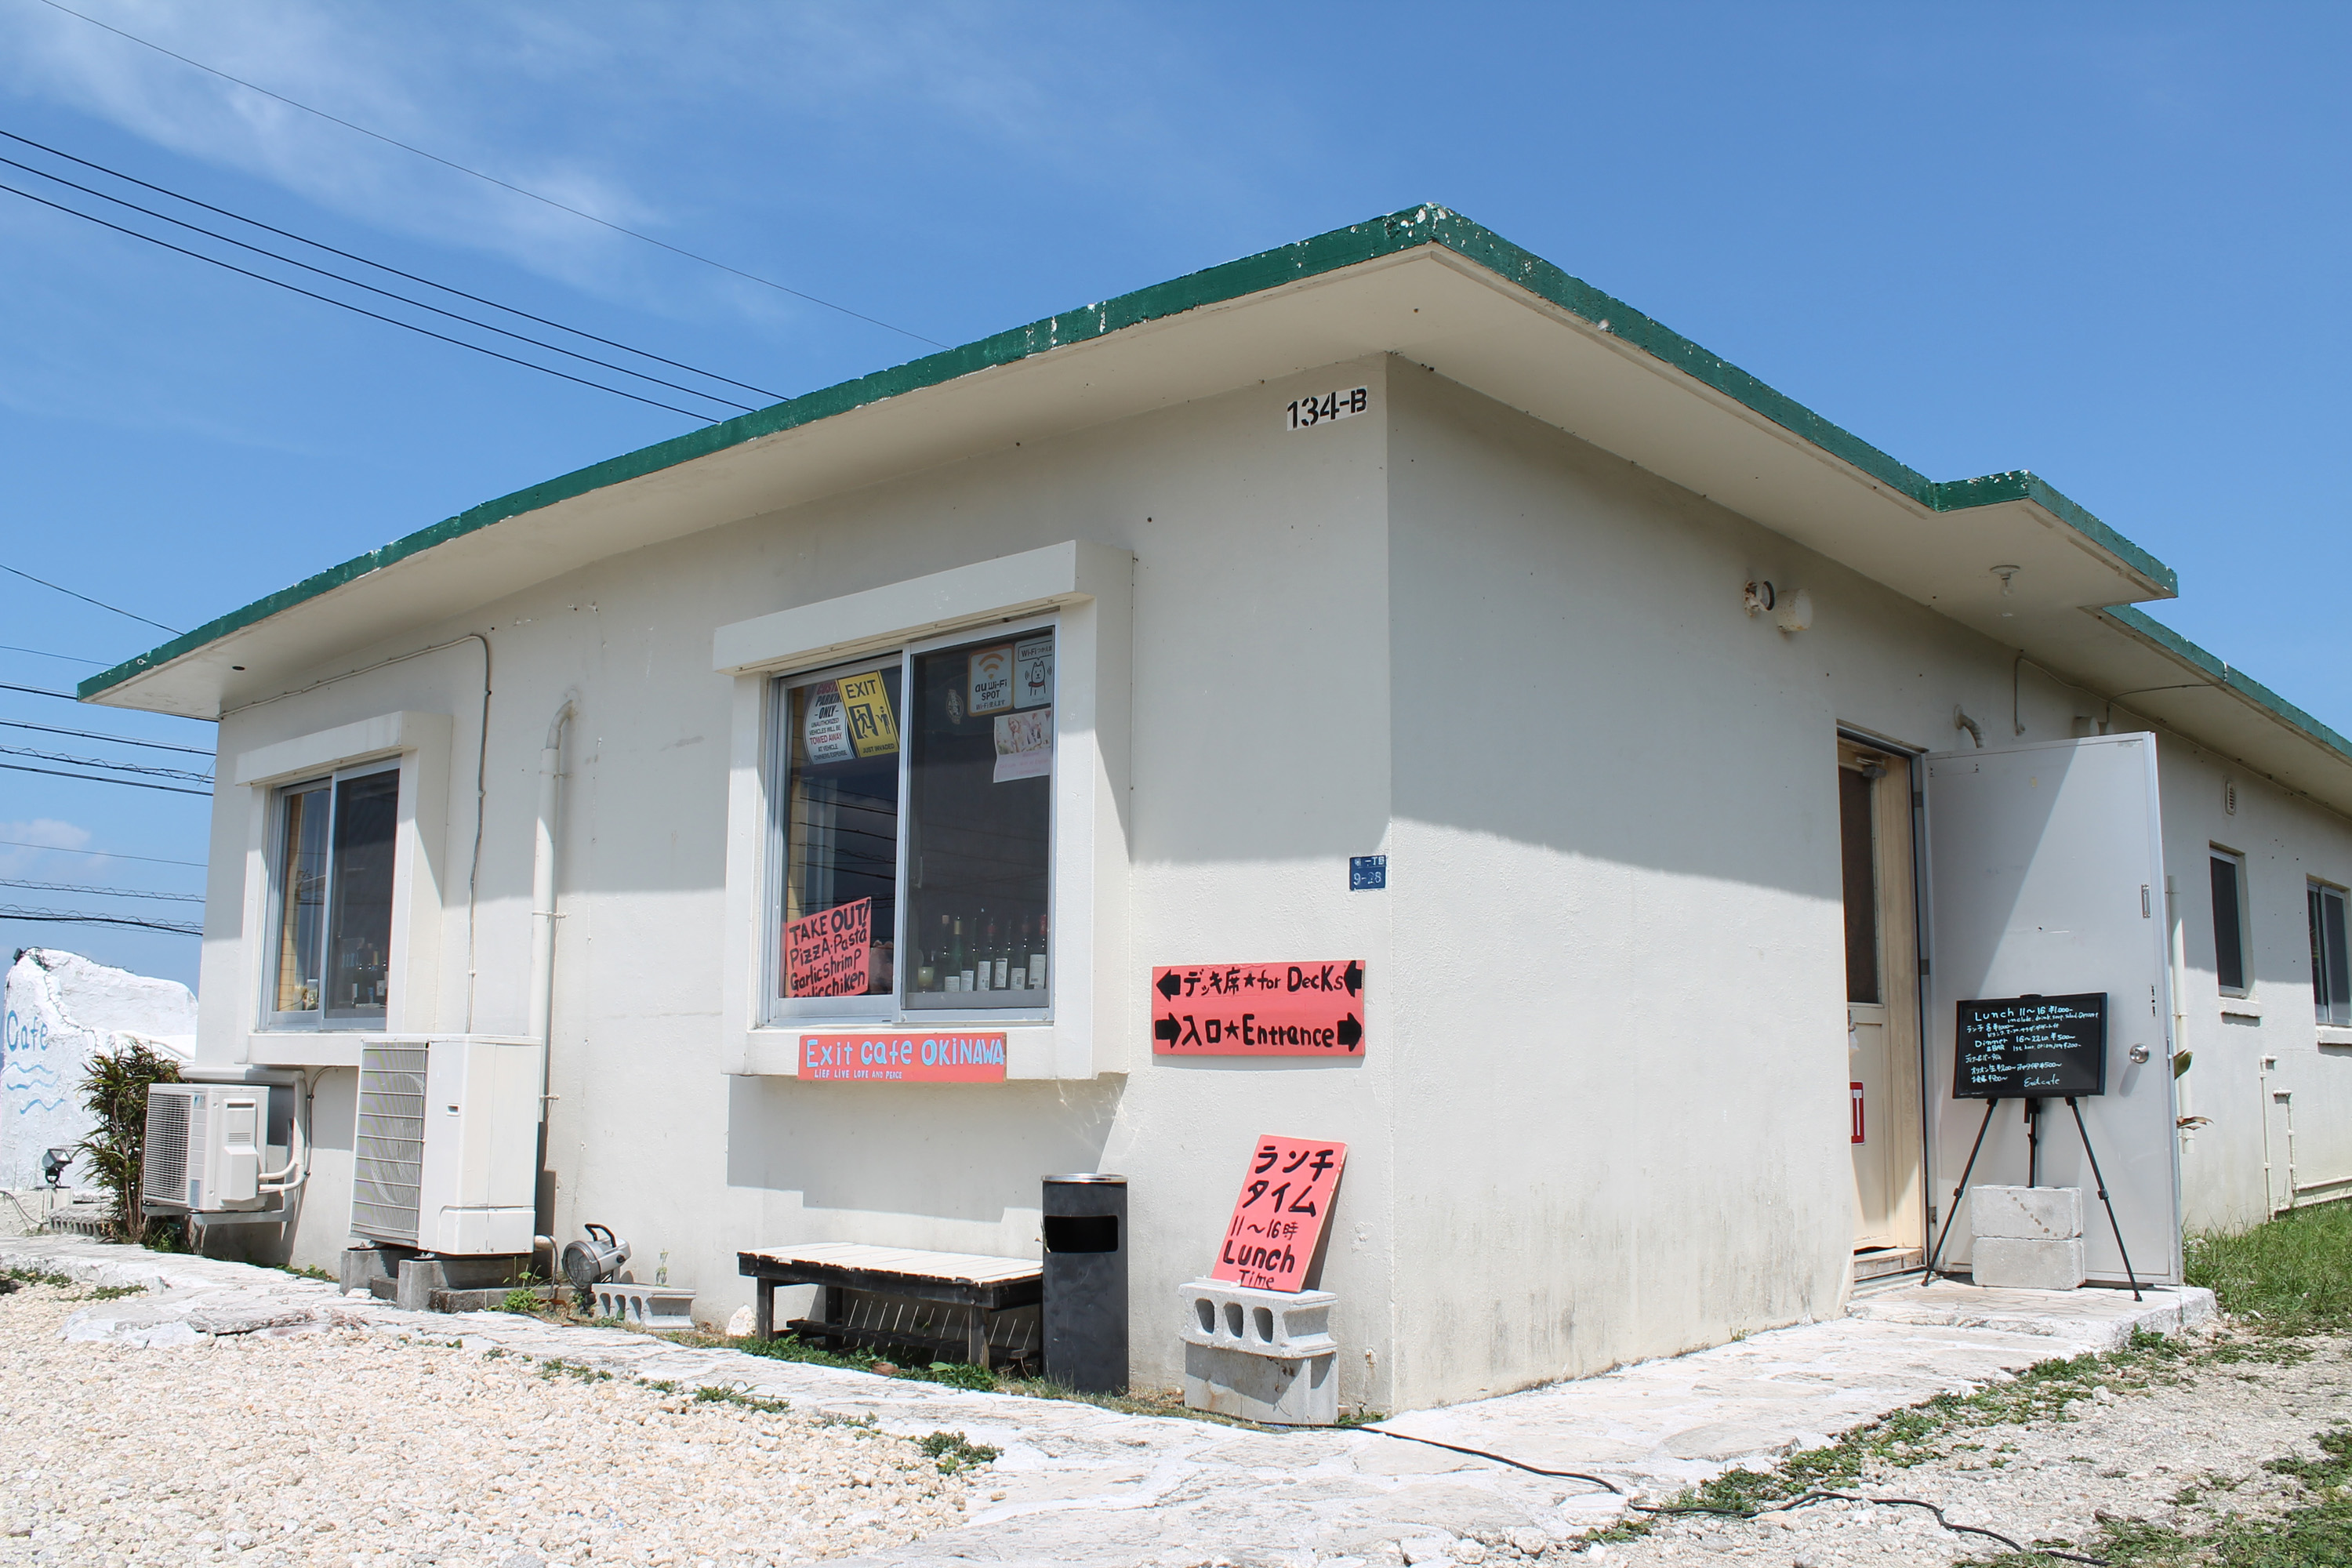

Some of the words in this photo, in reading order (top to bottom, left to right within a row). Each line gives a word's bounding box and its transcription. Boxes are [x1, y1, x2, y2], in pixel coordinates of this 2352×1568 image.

[1287, 388, 1367, 429] 134-B
[845, 679, 876, 699] EXIT
[975, 683, 987, 692] au
[988, 679, 1007, 690] Wi-Fi
[982, 690, 1000, 701] SPOT
[810, 735, 828, 745] TOWED
[829, 732, 842, 742] AWAY
[789, 915, 828, 946] TAKE
[831, 898, 870, 933] OUT!
[1184, 967, 1240, 996] デッキ席
[1257, 970, 1281, 991] for
[1975, 1007, 2014, 1022] Lunch
[6, 1010, 49, 1052] Cafe
[1181, 1014, 1221, 1047] 入口
[1243, 1014, 1334, 1047] Entrance
[1966, 1024, 1984, 1033] ランチ
[806, 1039, 853, 1068] Exit
[861, 1040, 913, 1065] cafe
[1975, 1038, 2008, 1047] Dinner
[854, 1069, 869, 1079] LOVE
[872, 1070, 884, 1079] AND
[885, 1070, 902, 1080] PEACE
[1255, 1145, 1334, 1181] ランチ
[1242, 1180, 1316, 1218] タイム
[1223, 1240, 1295, 1273] Lunch
[1239, 1269, 1275, 1290] Time
